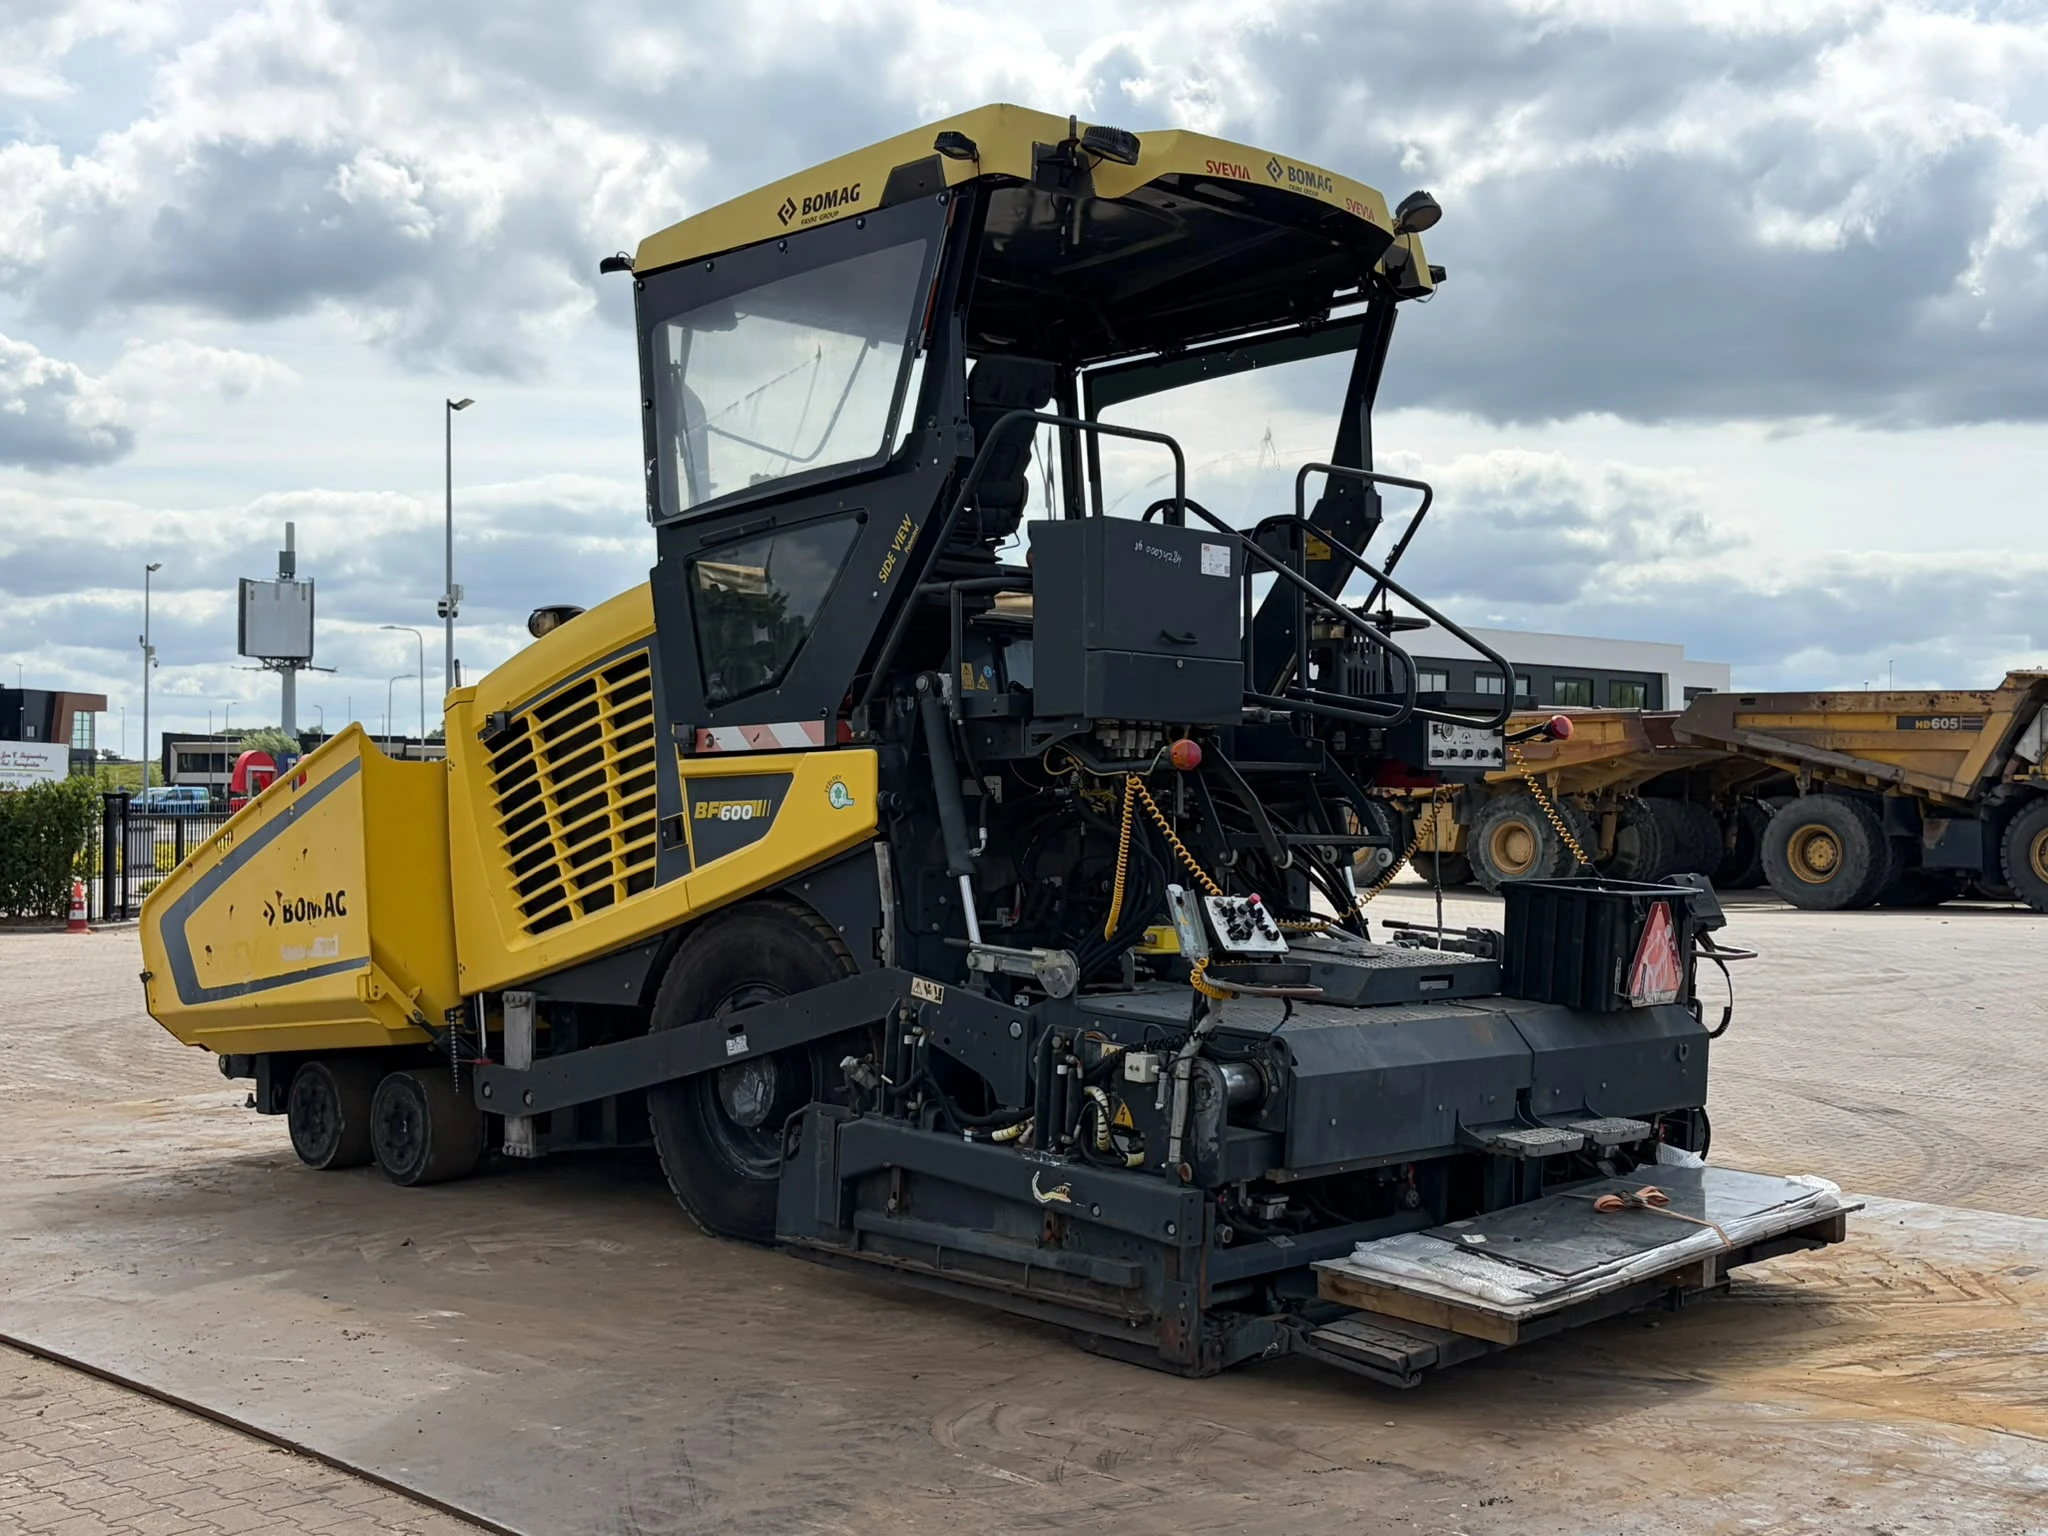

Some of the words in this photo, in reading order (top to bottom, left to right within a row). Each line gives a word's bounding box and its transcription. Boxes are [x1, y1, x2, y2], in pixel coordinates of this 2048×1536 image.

[1206, 160, 1251, 180] SVEVIA
[1287, 165, 1333, 193] BOMAG
[801, 183, 861, 216] BOMAG
[1345, 197, 1376, 222] SVEVIA
[878, 551, 896, 584] SIDE
[891, 512, 912, 552] VIEW
[1915, 717, 1959, 730] HD605
[694, 800, 753, 821] BF600
